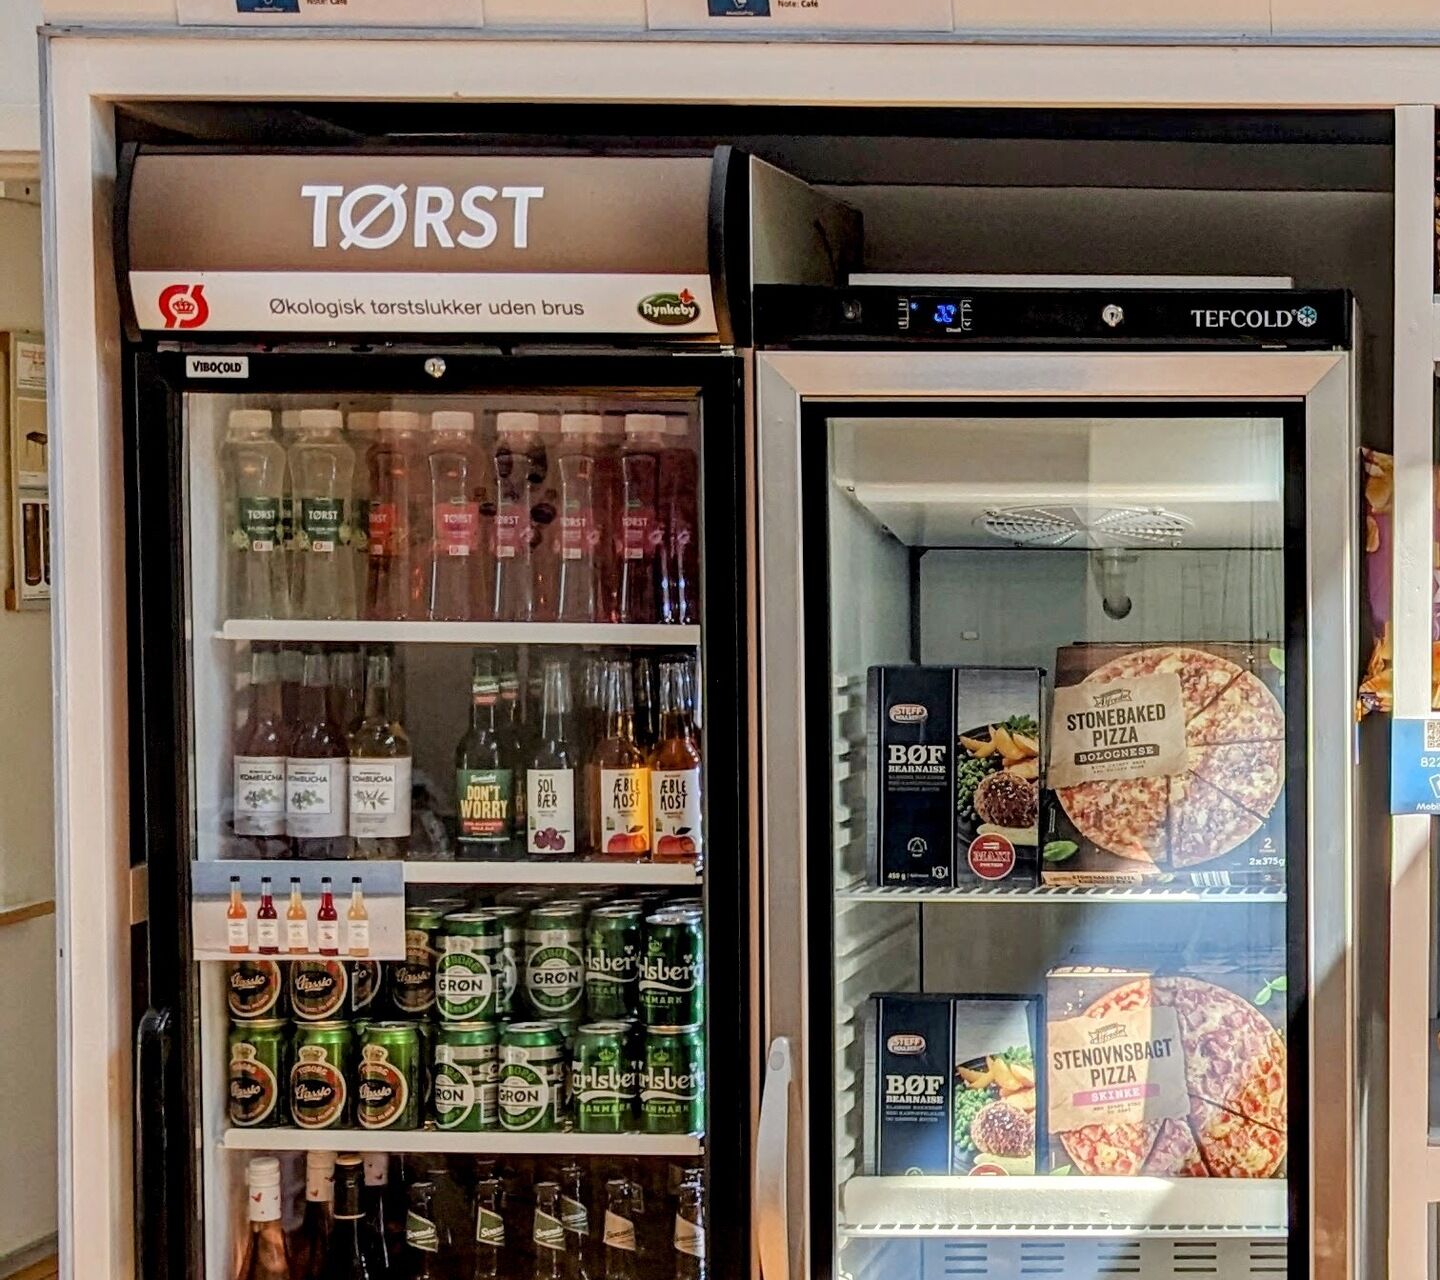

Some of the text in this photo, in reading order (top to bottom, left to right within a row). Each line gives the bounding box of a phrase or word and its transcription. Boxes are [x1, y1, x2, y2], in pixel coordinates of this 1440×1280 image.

[301, 184, 544, 250] TØRST
[270, 298, 584, 318] Økologisk tørstslukker uden brus
[643, 302, 696, 322] Rynkeby
[1191, 310, 1292, 328] TEFCOLD
[309, 511, 338, 520] TØRST
[1067, 703, 1166, 731] STONEBAKED
[1093, 727, 1139, 747] PIZZA
[888, 745, 946, 764] BØF
[1079, 745, 1155, 761] BOLOGNESE
[888, 765, 945, 773] BEARNAISE
[538, 779, 555, 793] SOL
[460, 800, 508, 818] WORRY
[538, 794, 557, 807] BÆR
[613, 792, 640, 809] MOST
[660, 793, 687, 810] MOST
[439, 978, 482, 991] GRØN
[533, 972, 578, 984] GRØN
[1053, 1039, 1172, 1070] STENOVNSBAGT
[886, 1074, 944, 1096] BØF
[1090, 1068, 1137, 1088] PIZZA
[886, 1095, 943, 1104] BEARNAISE
[1091, 1088, 1140, 1101] SKINKE
